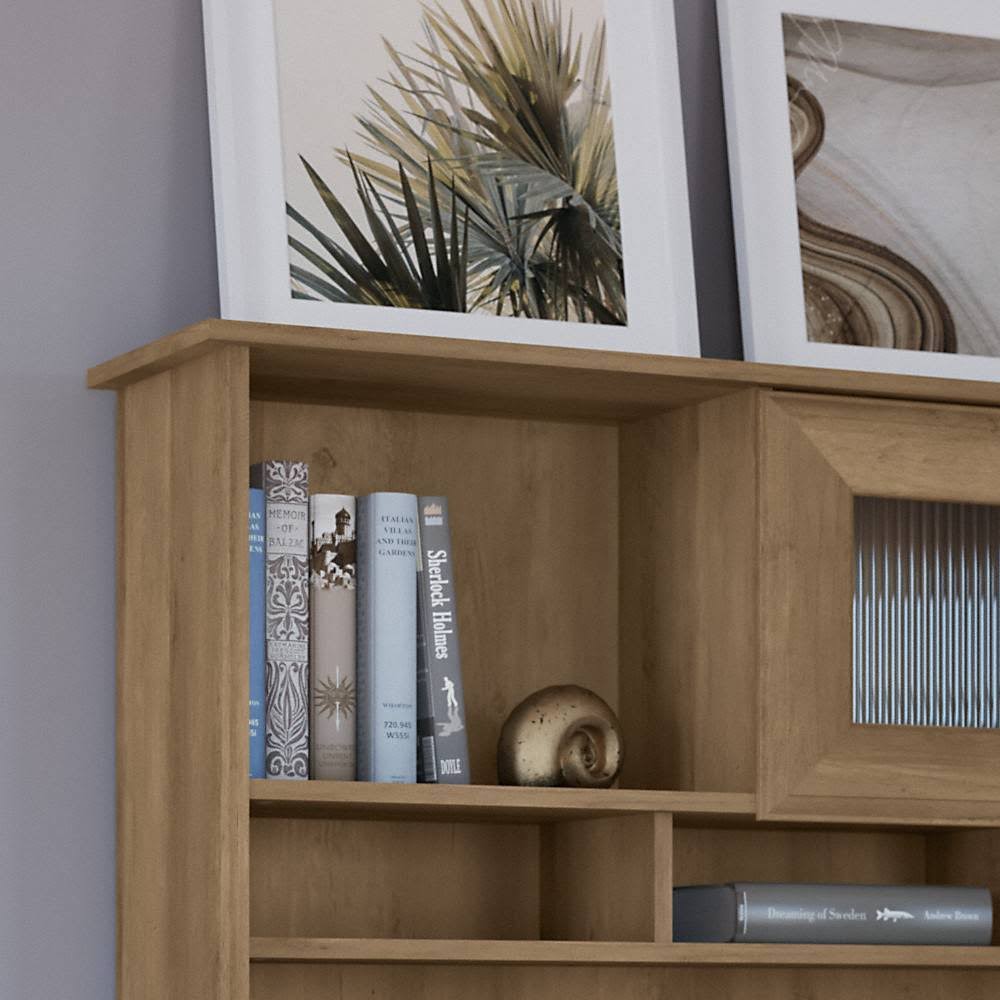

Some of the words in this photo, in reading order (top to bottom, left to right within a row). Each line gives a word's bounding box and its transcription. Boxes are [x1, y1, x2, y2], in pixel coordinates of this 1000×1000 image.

[268, 508, 306, 521] MEMOIR
[381, 515, 414, 524] ITALIAN
[384, 526, 412, 535] VILLAS
[376, 537, 394, 545] AND
[397, 538, 417, 547] THEIR
[378, 548, 416, 558] GARDENS
[426, 549, 448, 607] Sherlock
[431, 610, 453, 661] Holmes
[440, 758, 462, 775] DOYLE
[767, 906, 815, 925] Dreaming
[816, 907, 828, 920] of
[828, 907, 867, 921] Sweden
